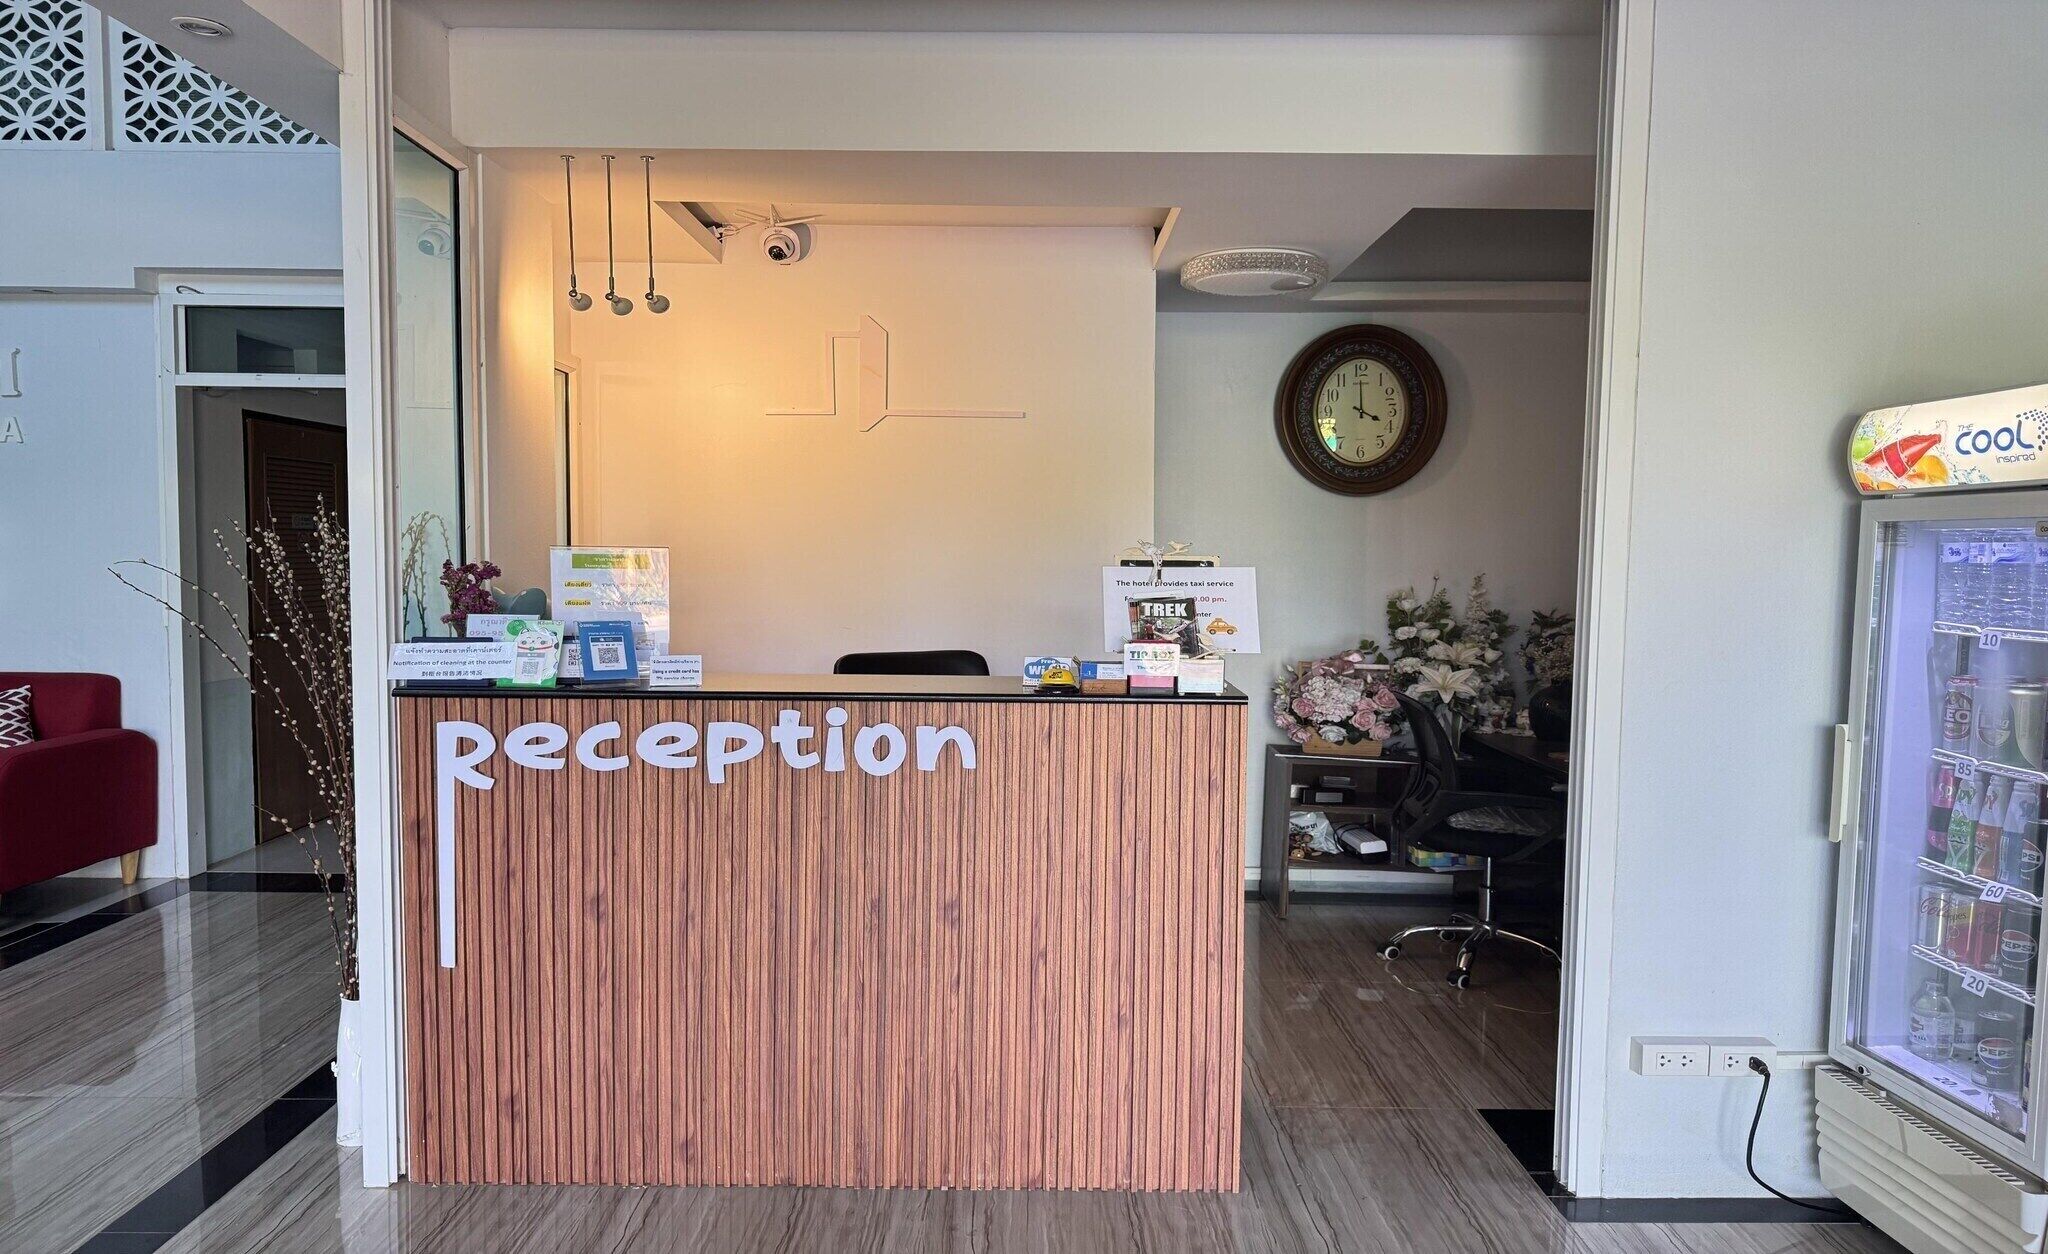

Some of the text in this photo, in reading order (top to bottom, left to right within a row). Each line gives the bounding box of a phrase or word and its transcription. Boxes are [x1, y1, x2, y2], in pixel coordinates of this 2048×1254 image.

[1355, 363, 1368, 377] 12
[1337, 373, 1346, 387] 11
[1327, 389, 1339, 402] 10
[1385, 387, 1395, 401] 2
[1324, 405, 1333, 418] 9
[1388, 403, 1397, 417] 3
[1384, 420, 1393, 433] 4
[1377, 435, 1385, 449] 5
[1356, 445, 1365, 459] 6
[1995, 451, 2037, 464] inspired
[1154, 580, 1188, 588] provides
[1140, 602, 1188, 617] TREK
[1982, 633, 1998, 647] 10
[1129, 650, 1148, 659] TIP
[1957, 762, 1972, 777] 85
[1985, 885, 2004, 899] 60
[1966, 975, 1986, 993] 20
